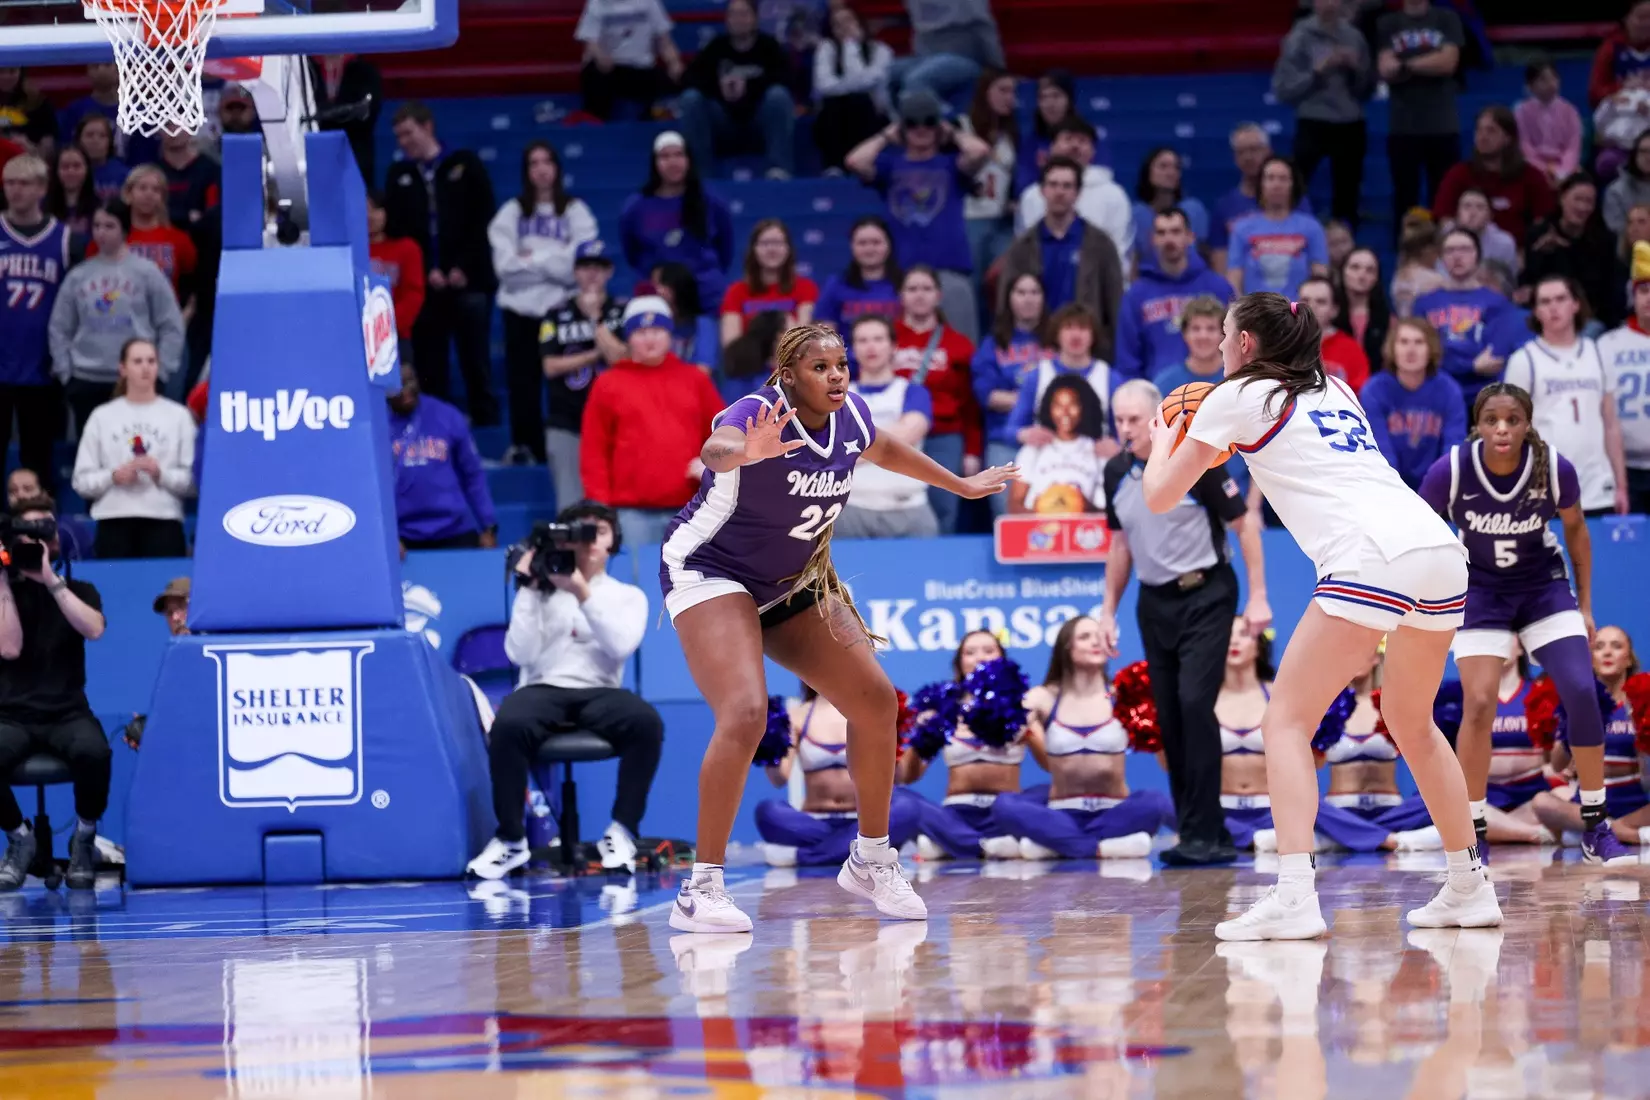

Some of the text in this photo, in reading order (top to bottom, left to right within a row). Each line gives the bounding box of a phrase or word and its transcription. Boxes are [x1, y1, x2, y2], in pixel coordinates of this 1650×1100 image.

[6, 281, 44, 310] 77
[1571, 398, 1580, 423] 1
[1307, 409, 1379, 453] 52
[787, 469, 852, 498] Wildcat
[251, 505, 328, 535] Ford
[788, 502, 843, 541] 22
[1465, 510, 1542, 535] Wildcats
[1494, 539, 1518, 568] 5
[925, 577, 1107, 600] BlueCross BlueShiel
[233, 687, 346, 709] SHELTER
[234, 710, 346, 727] INSURANCE
